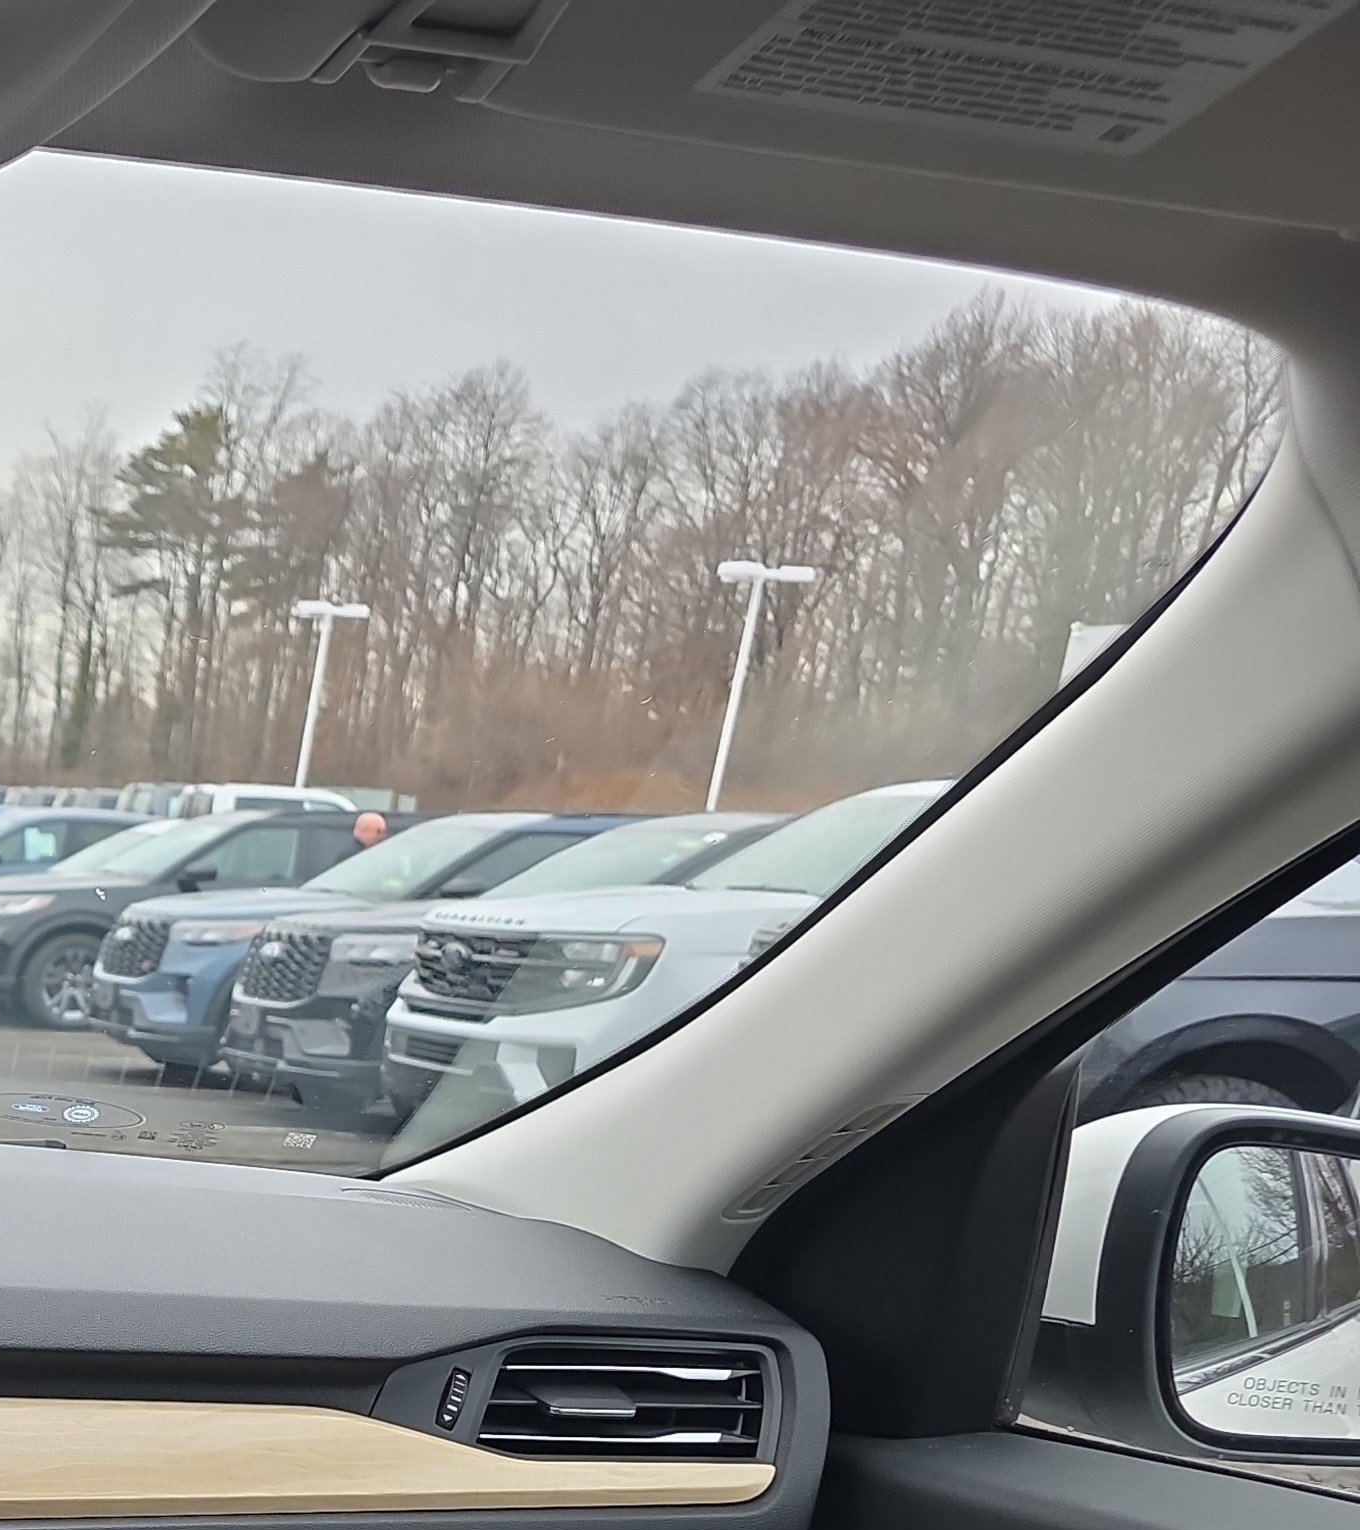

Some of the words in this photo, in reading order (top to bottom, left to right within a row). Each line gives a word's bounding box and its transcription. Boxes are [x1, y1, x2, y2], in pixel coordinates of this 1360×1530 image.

[1243, 1377, 1320, 1396] OBJECTS
[1329, 1385, 1348, 1399] IN
[1227, 1391, 1293, 1411] CLOSER
[1302, 1399, 1348, 1415] THAN
